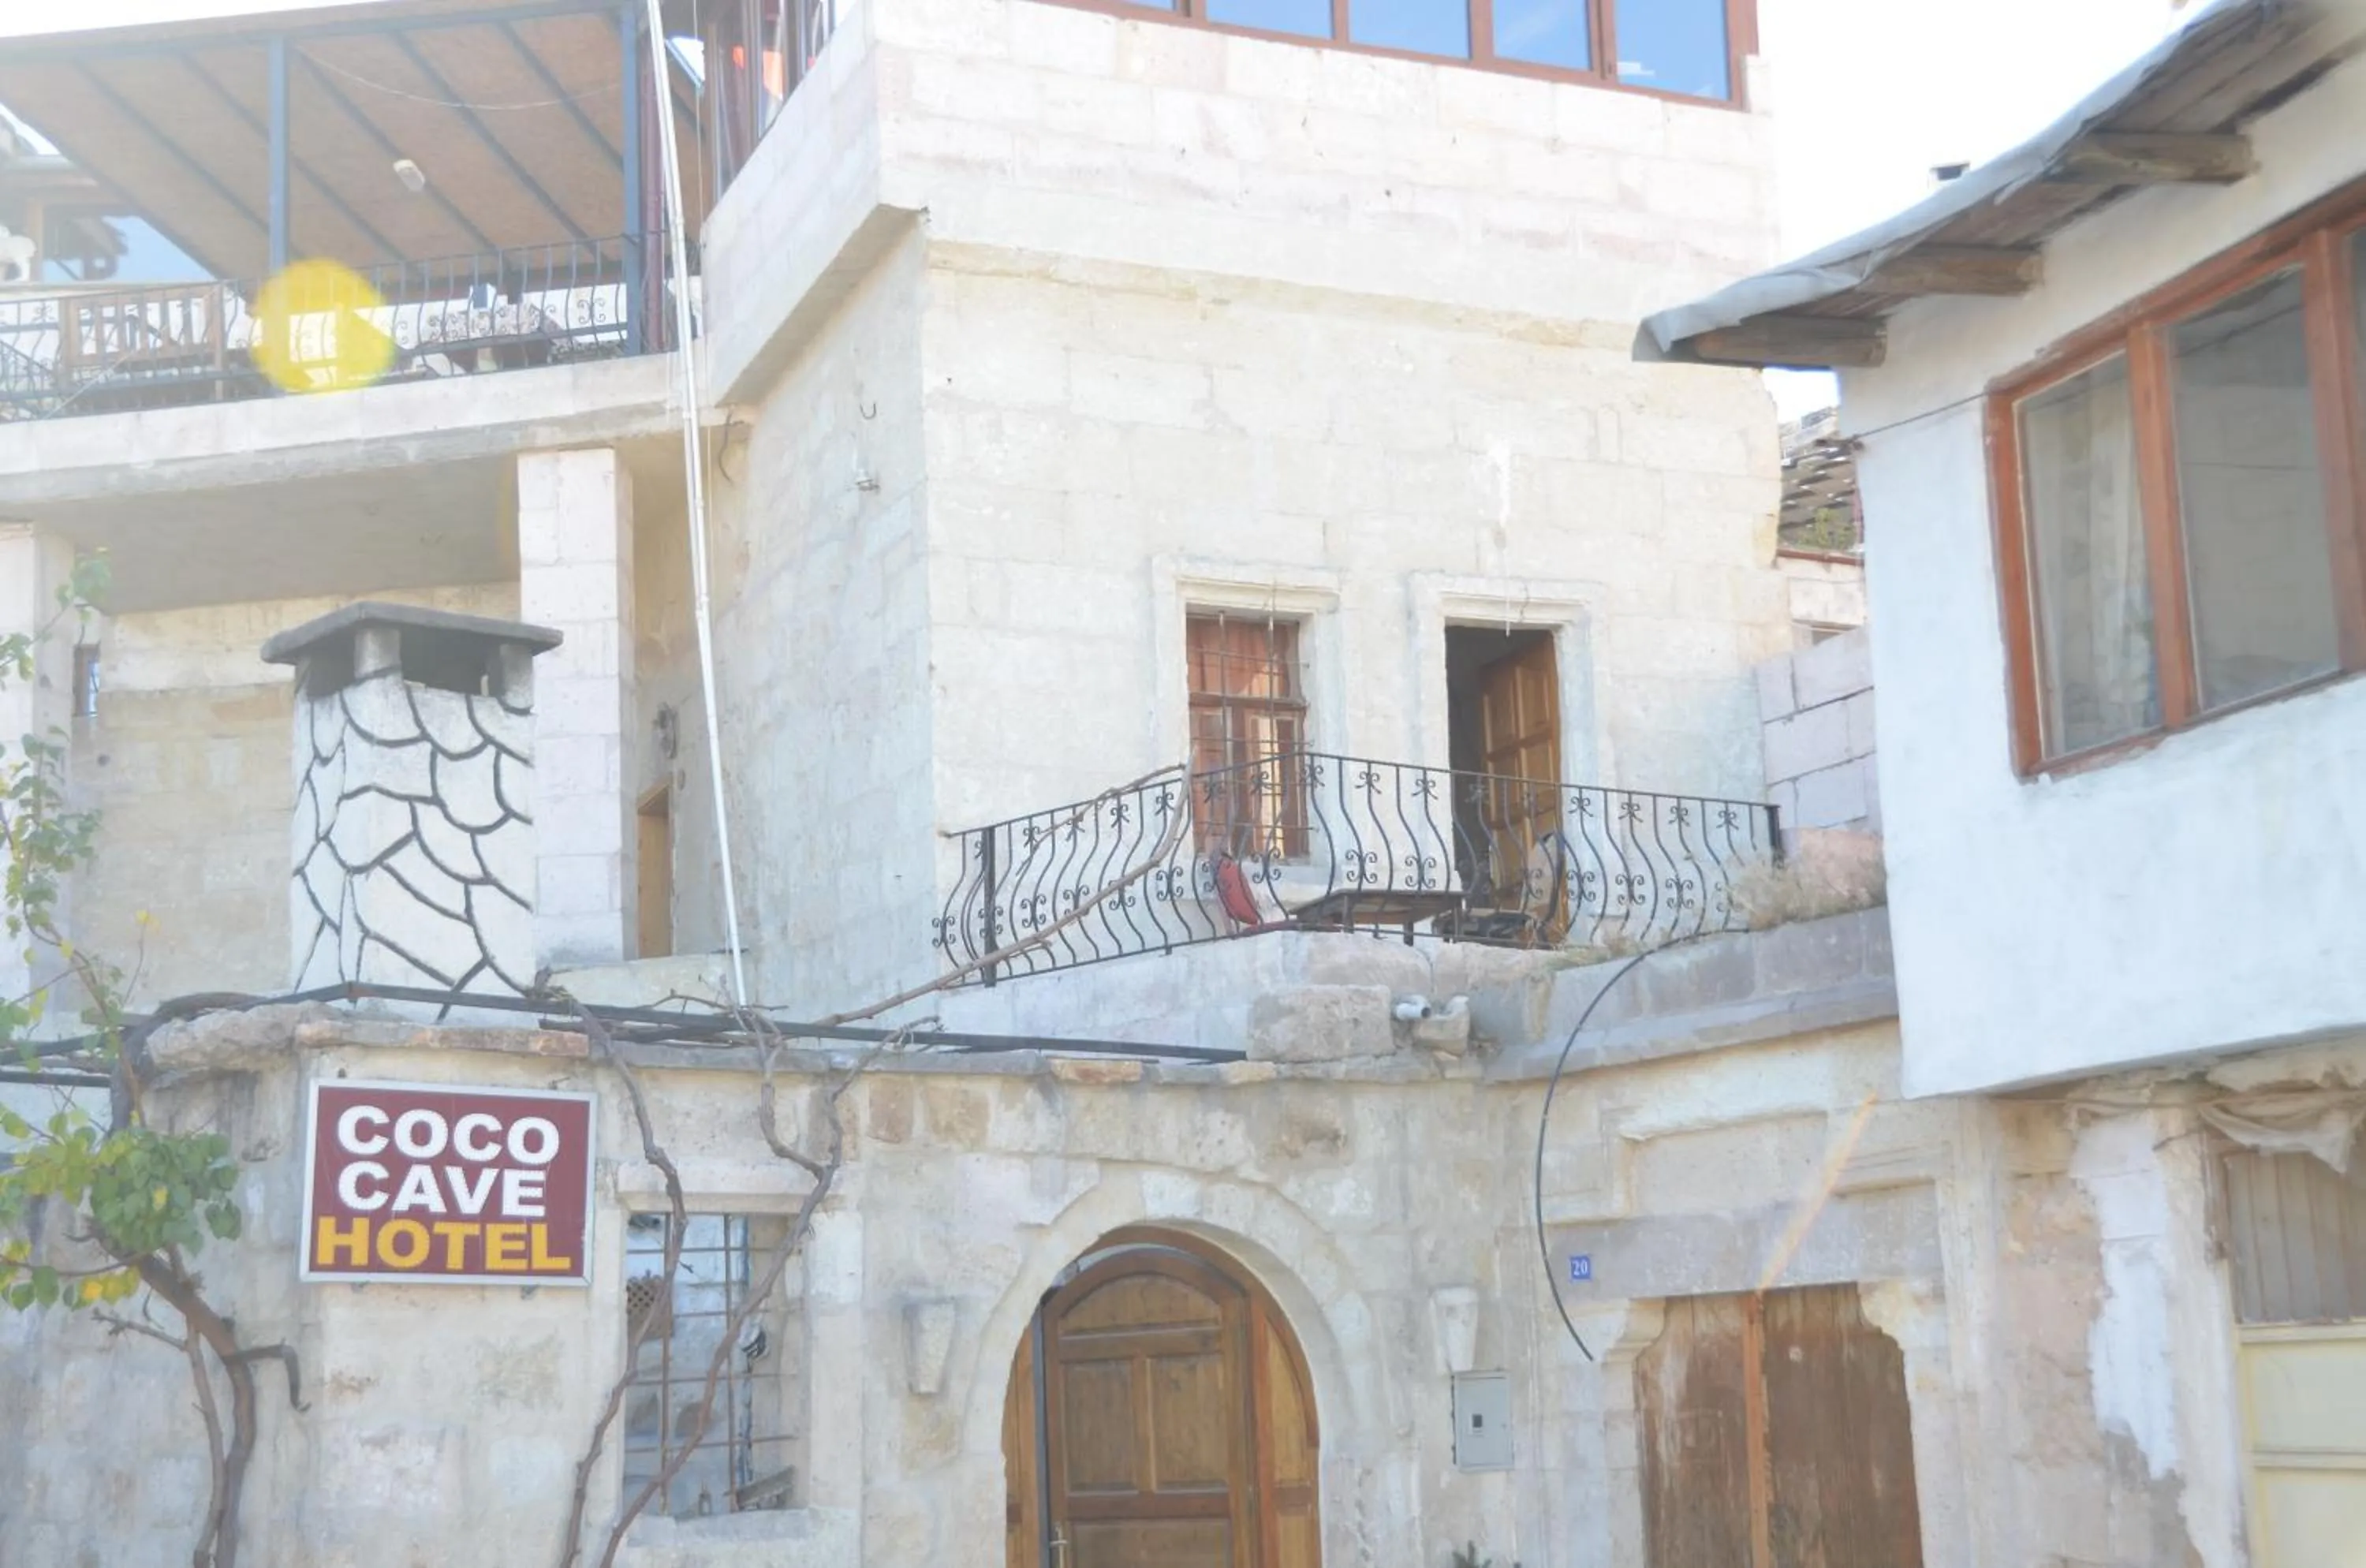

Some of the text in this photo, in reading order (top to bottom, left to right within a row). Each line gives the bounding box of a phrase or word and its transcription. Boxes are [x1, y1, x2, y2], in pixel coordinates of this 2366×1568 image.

[338, 1105, 559, 1163] COCO
[338, 1161, 546, 1216] CAVE
[317, 1216, 571, 1271] HOTEL
[1572, 1259, 1588, 1275] 20
